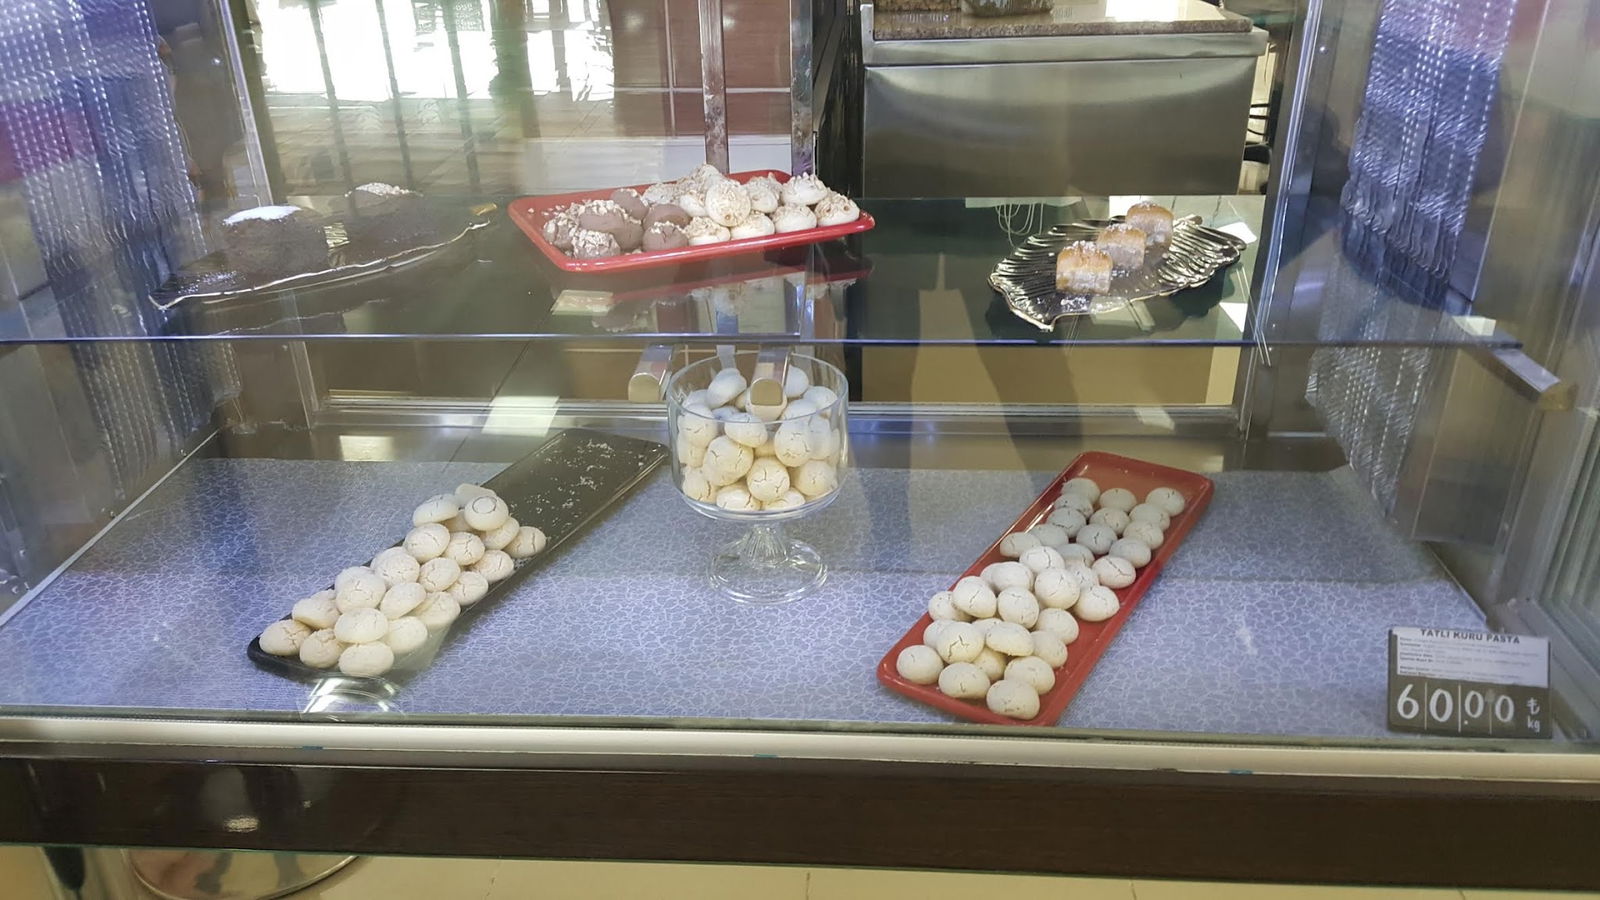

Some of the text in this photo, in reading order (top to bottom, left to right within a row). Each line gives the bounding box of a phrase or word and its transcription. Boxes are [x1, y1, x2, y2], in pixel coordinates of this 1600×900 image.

[1420, 628, 1450, 638] TATLI
[1453, 631, 1483, 641] KURU
[1486, 634, 1520, 645] PASTA
[1527, 716, 1541, 732] kg
